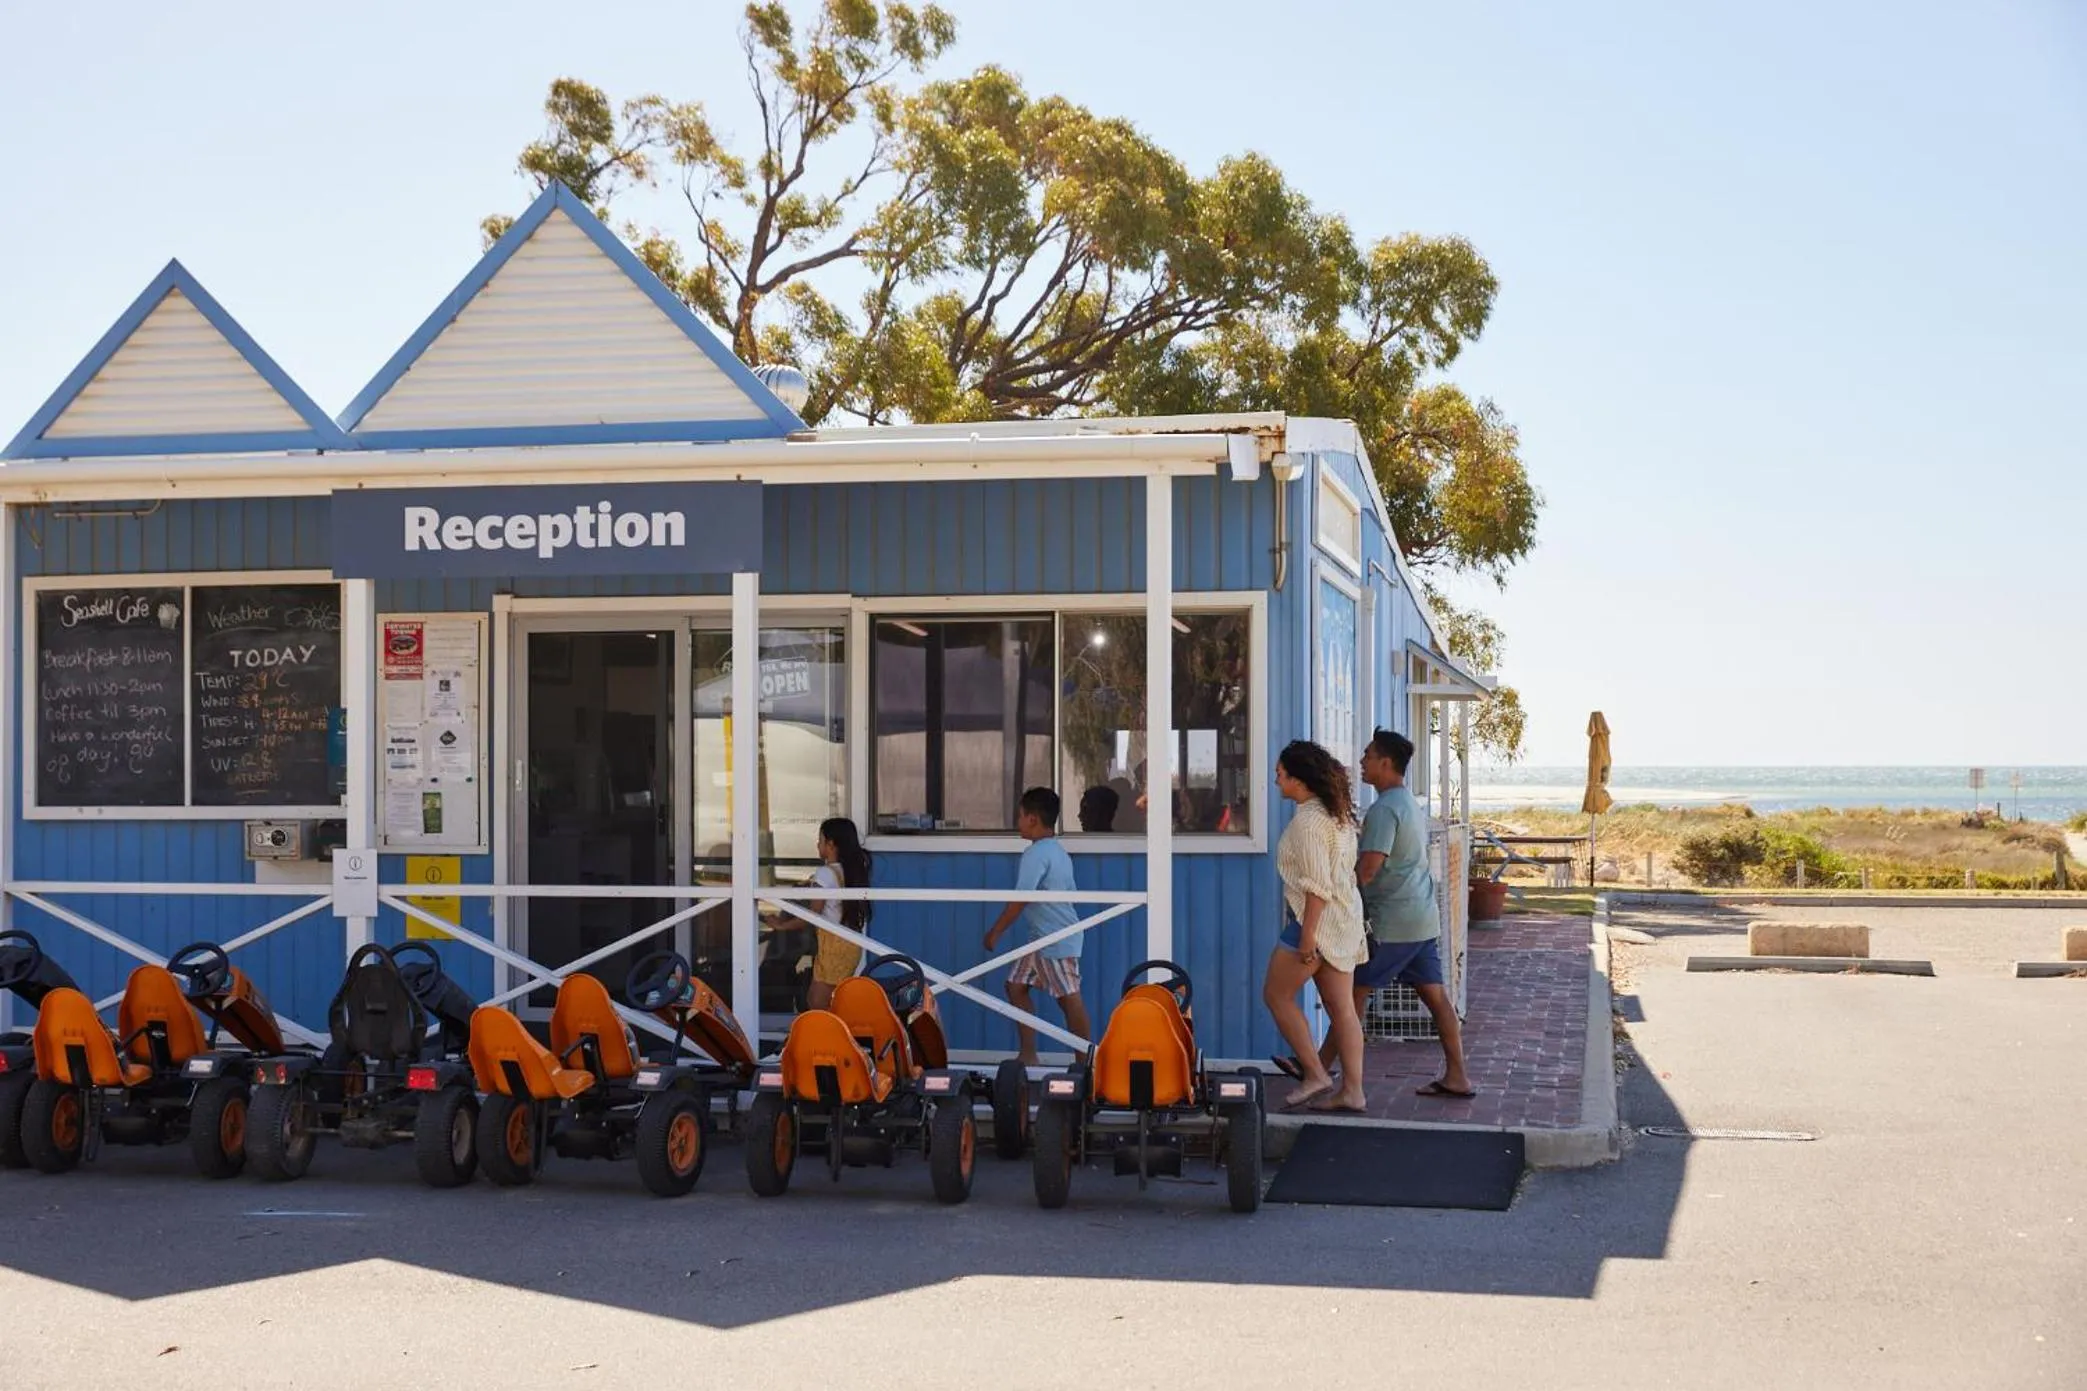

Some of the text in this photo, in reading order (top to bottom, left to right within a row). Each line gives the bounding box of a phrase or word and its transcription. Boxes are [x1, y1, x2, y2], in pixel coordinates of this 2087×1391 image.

[405, 500, 686, 558] Reception
[206, 603, 275, 629] Weather
[228, 644, 317, 668] TODAY
[762, 670, 808, 697] OPEN
